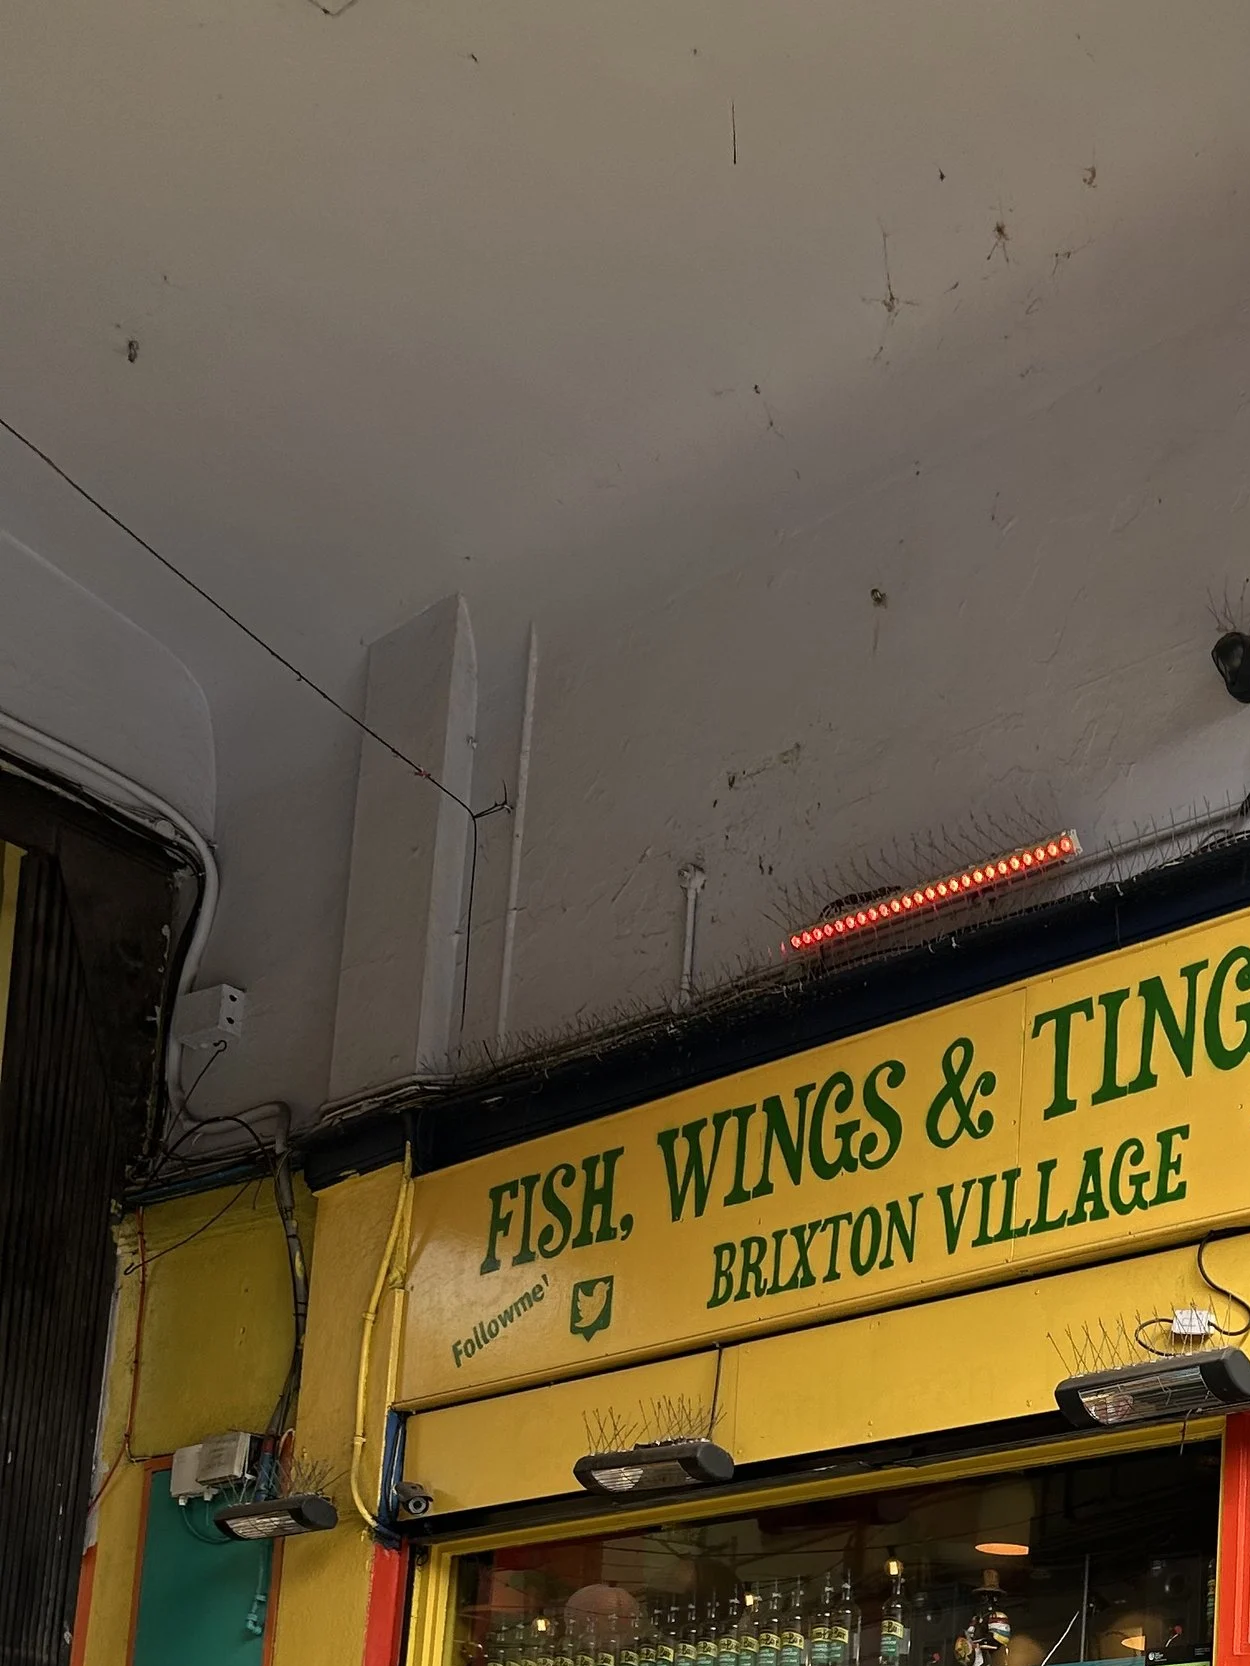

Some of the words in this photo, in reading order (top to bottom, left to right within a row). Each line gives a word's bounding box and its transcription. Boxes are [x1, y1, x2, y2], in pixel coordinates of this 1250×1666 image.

[480, 1146, 634, 1275] FISH,
[657, 1059, 906, 1222] WINGS
[926, 1037, 996, 1149] &
[707, 1193, 921, 1308] BRIXTON
[937, 1124, 1190, 1254] VILLAGE
